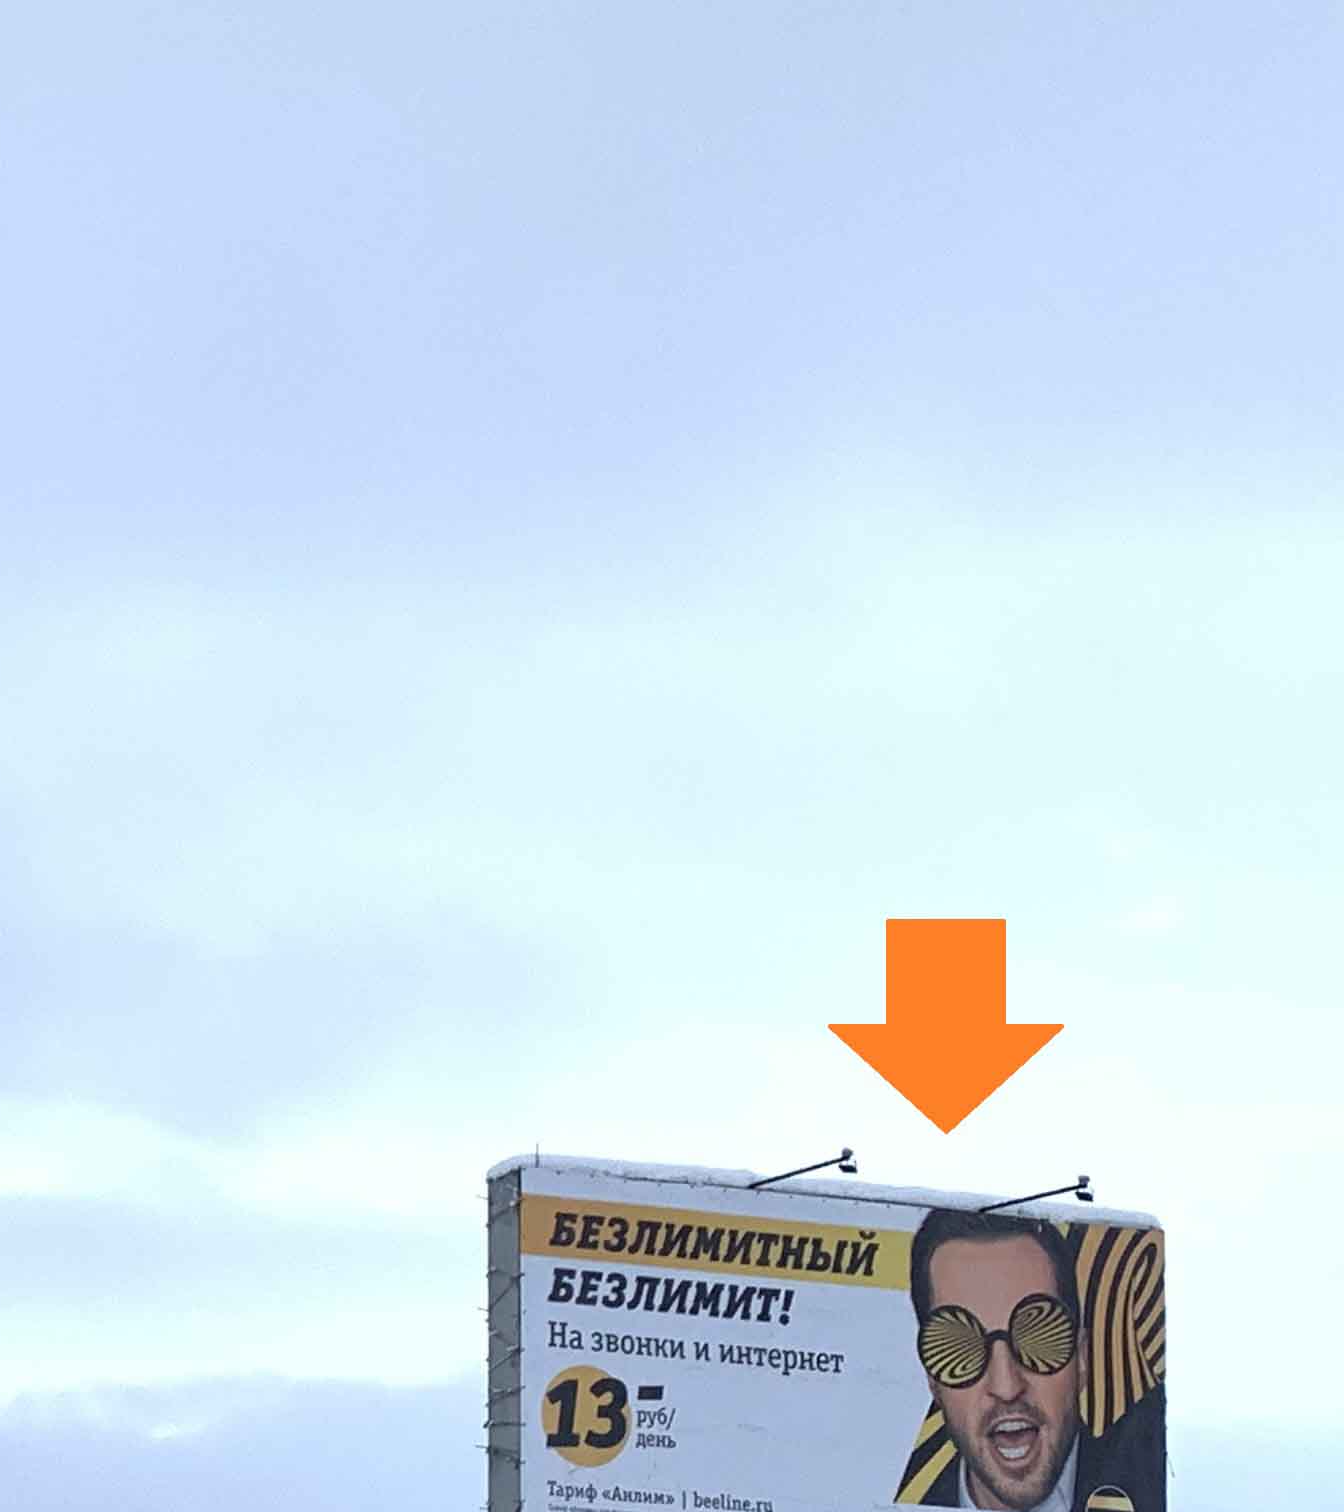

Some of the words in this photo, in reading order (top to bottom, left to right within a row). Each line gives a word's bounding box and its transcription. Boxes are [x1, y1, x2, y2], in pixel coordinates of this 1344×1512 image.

[549, 1211, 880, 1277] БЕЗЛИМИТНЫЙ
[547, 1267, 795, 1326] БЕЗЛИМИТ!
[547, 1320, 585, 1350] На
[591, 1331, 686, 1359] звонки
[693, 1341, 711, 1362] и
[719, 1344, 845, 1376] интернет
[545, 1377, 628, 1449] 13
[636, 1407, 676, 1430] руб/
[636, 1432, 676, 1449] день
[547, 1480, 597, 1503] Тариф
[602, 1486, 675, 1505] «Анлим»
